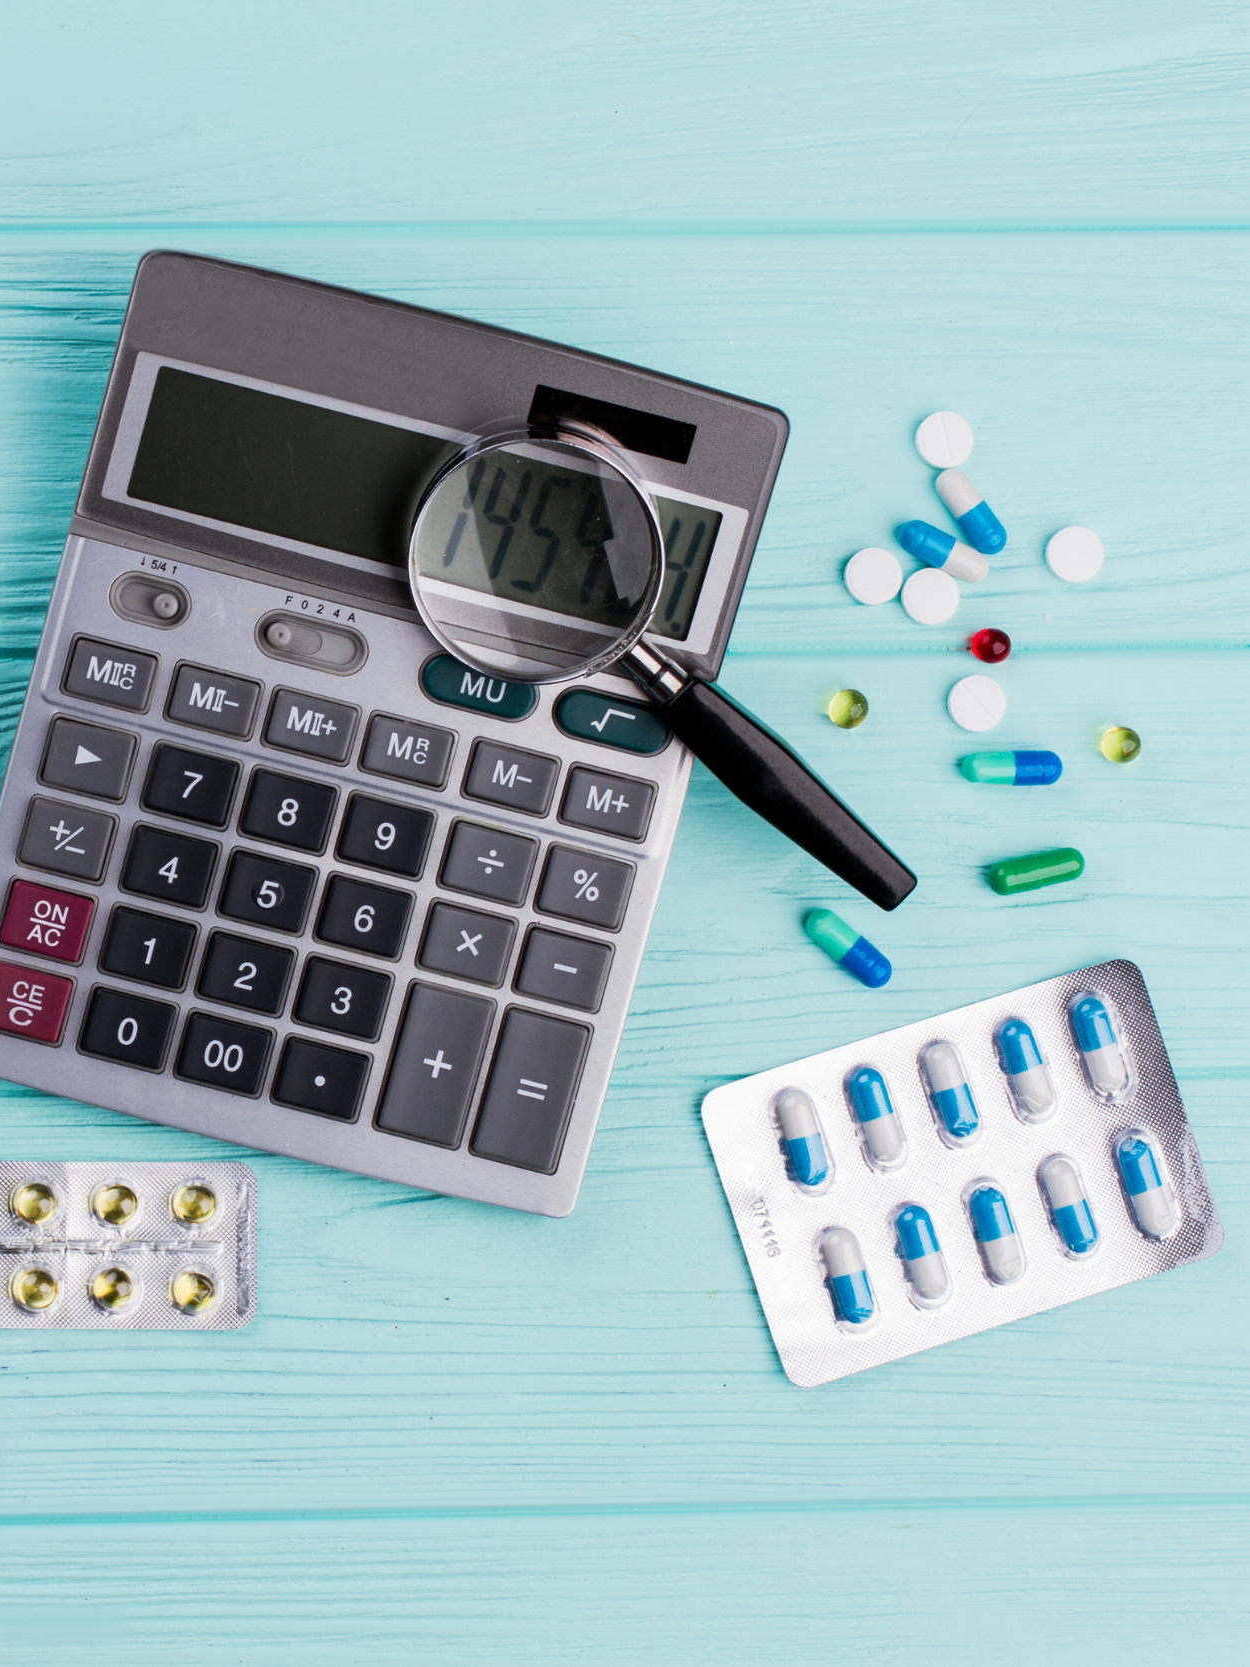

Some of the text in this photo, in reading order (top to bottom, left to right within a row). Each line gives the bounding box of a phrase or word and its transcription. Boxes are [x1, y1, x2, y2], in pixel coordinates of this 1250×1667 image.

[151, 560, 167, 572] 5/4
[285, 595, 293, 605] F
[316, 604, 324, 614] 2
[333, 608, 340, 618] 4
[347, 612, 356, 623] A
[459, 671, 507, 703] MU
[182, 770, 204, 799] 7
[277, 798, 299, 827] 8
[585, 785, 630, 814] M+
[374, 822, 396, 850] 9
[158, 856, 179, 884] 4
[256, 880, 280, 909] 5
[573, 869, 600, 902] %
[34, 900, 69, 924] ON
[354, 904, 375, 933] 6
[26, 924, 61, 947] AC
[143, 937, 157, 965] 1
[233, 961, 257, 991] 2
[12, 981, 45, 1004] CE
[330, 986, 353, 1015] 3
[8, 1006, 34, 1026] C
[117, 1017, 138, 1046] 0
[203, 1039, 244, 1073] 00
